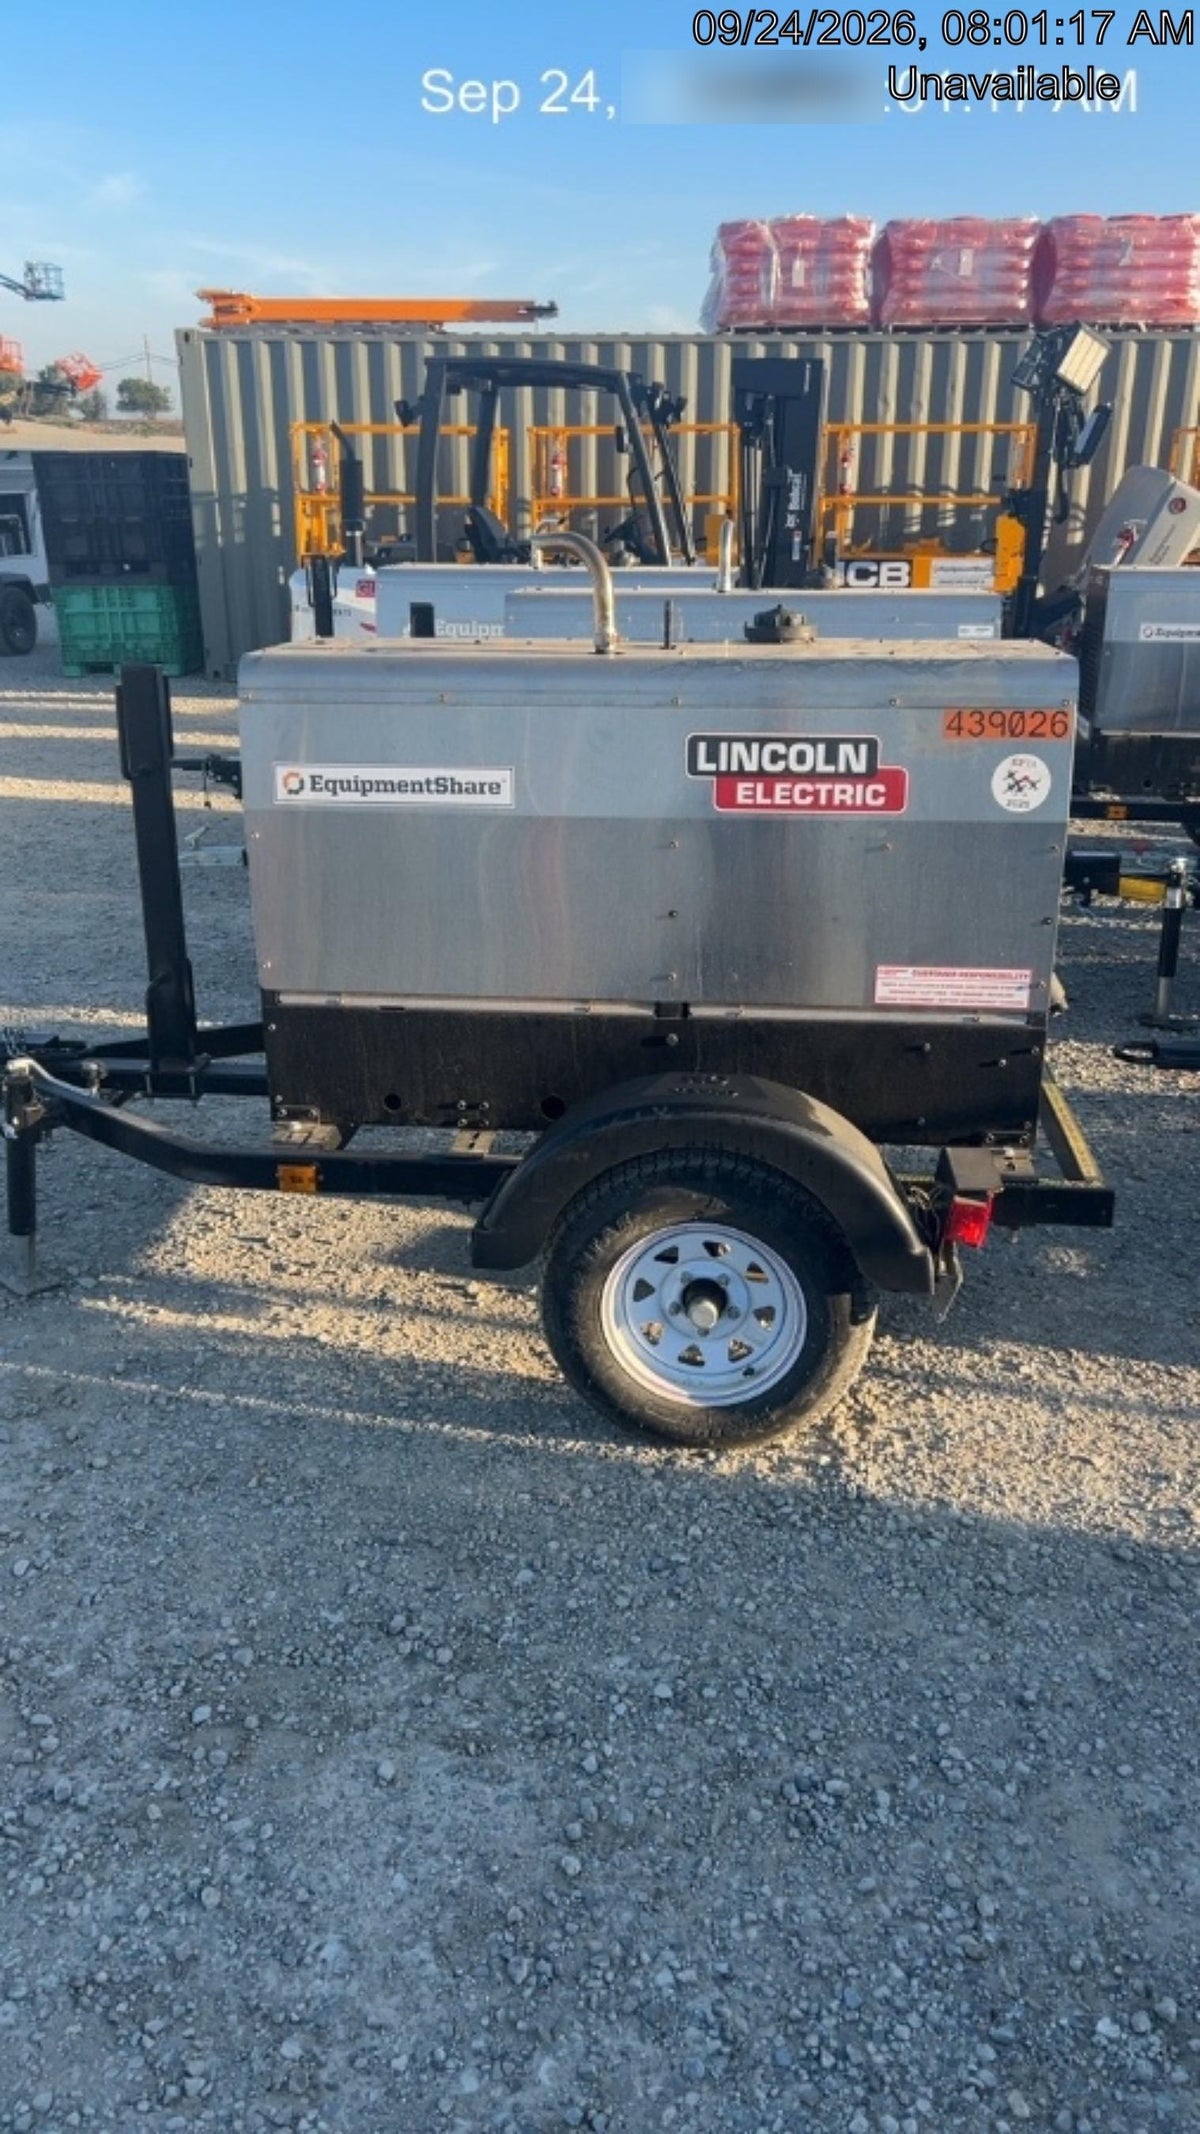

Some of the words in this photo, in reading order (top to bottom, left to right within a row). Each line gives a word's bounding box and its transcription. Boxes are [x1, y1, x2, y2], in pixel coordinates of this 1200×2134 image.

[945, 709, 1069, 738] 439026
[696, 740, 870, 774] LINCOLN
[735, 780, 888, 808] ELECTRIC
